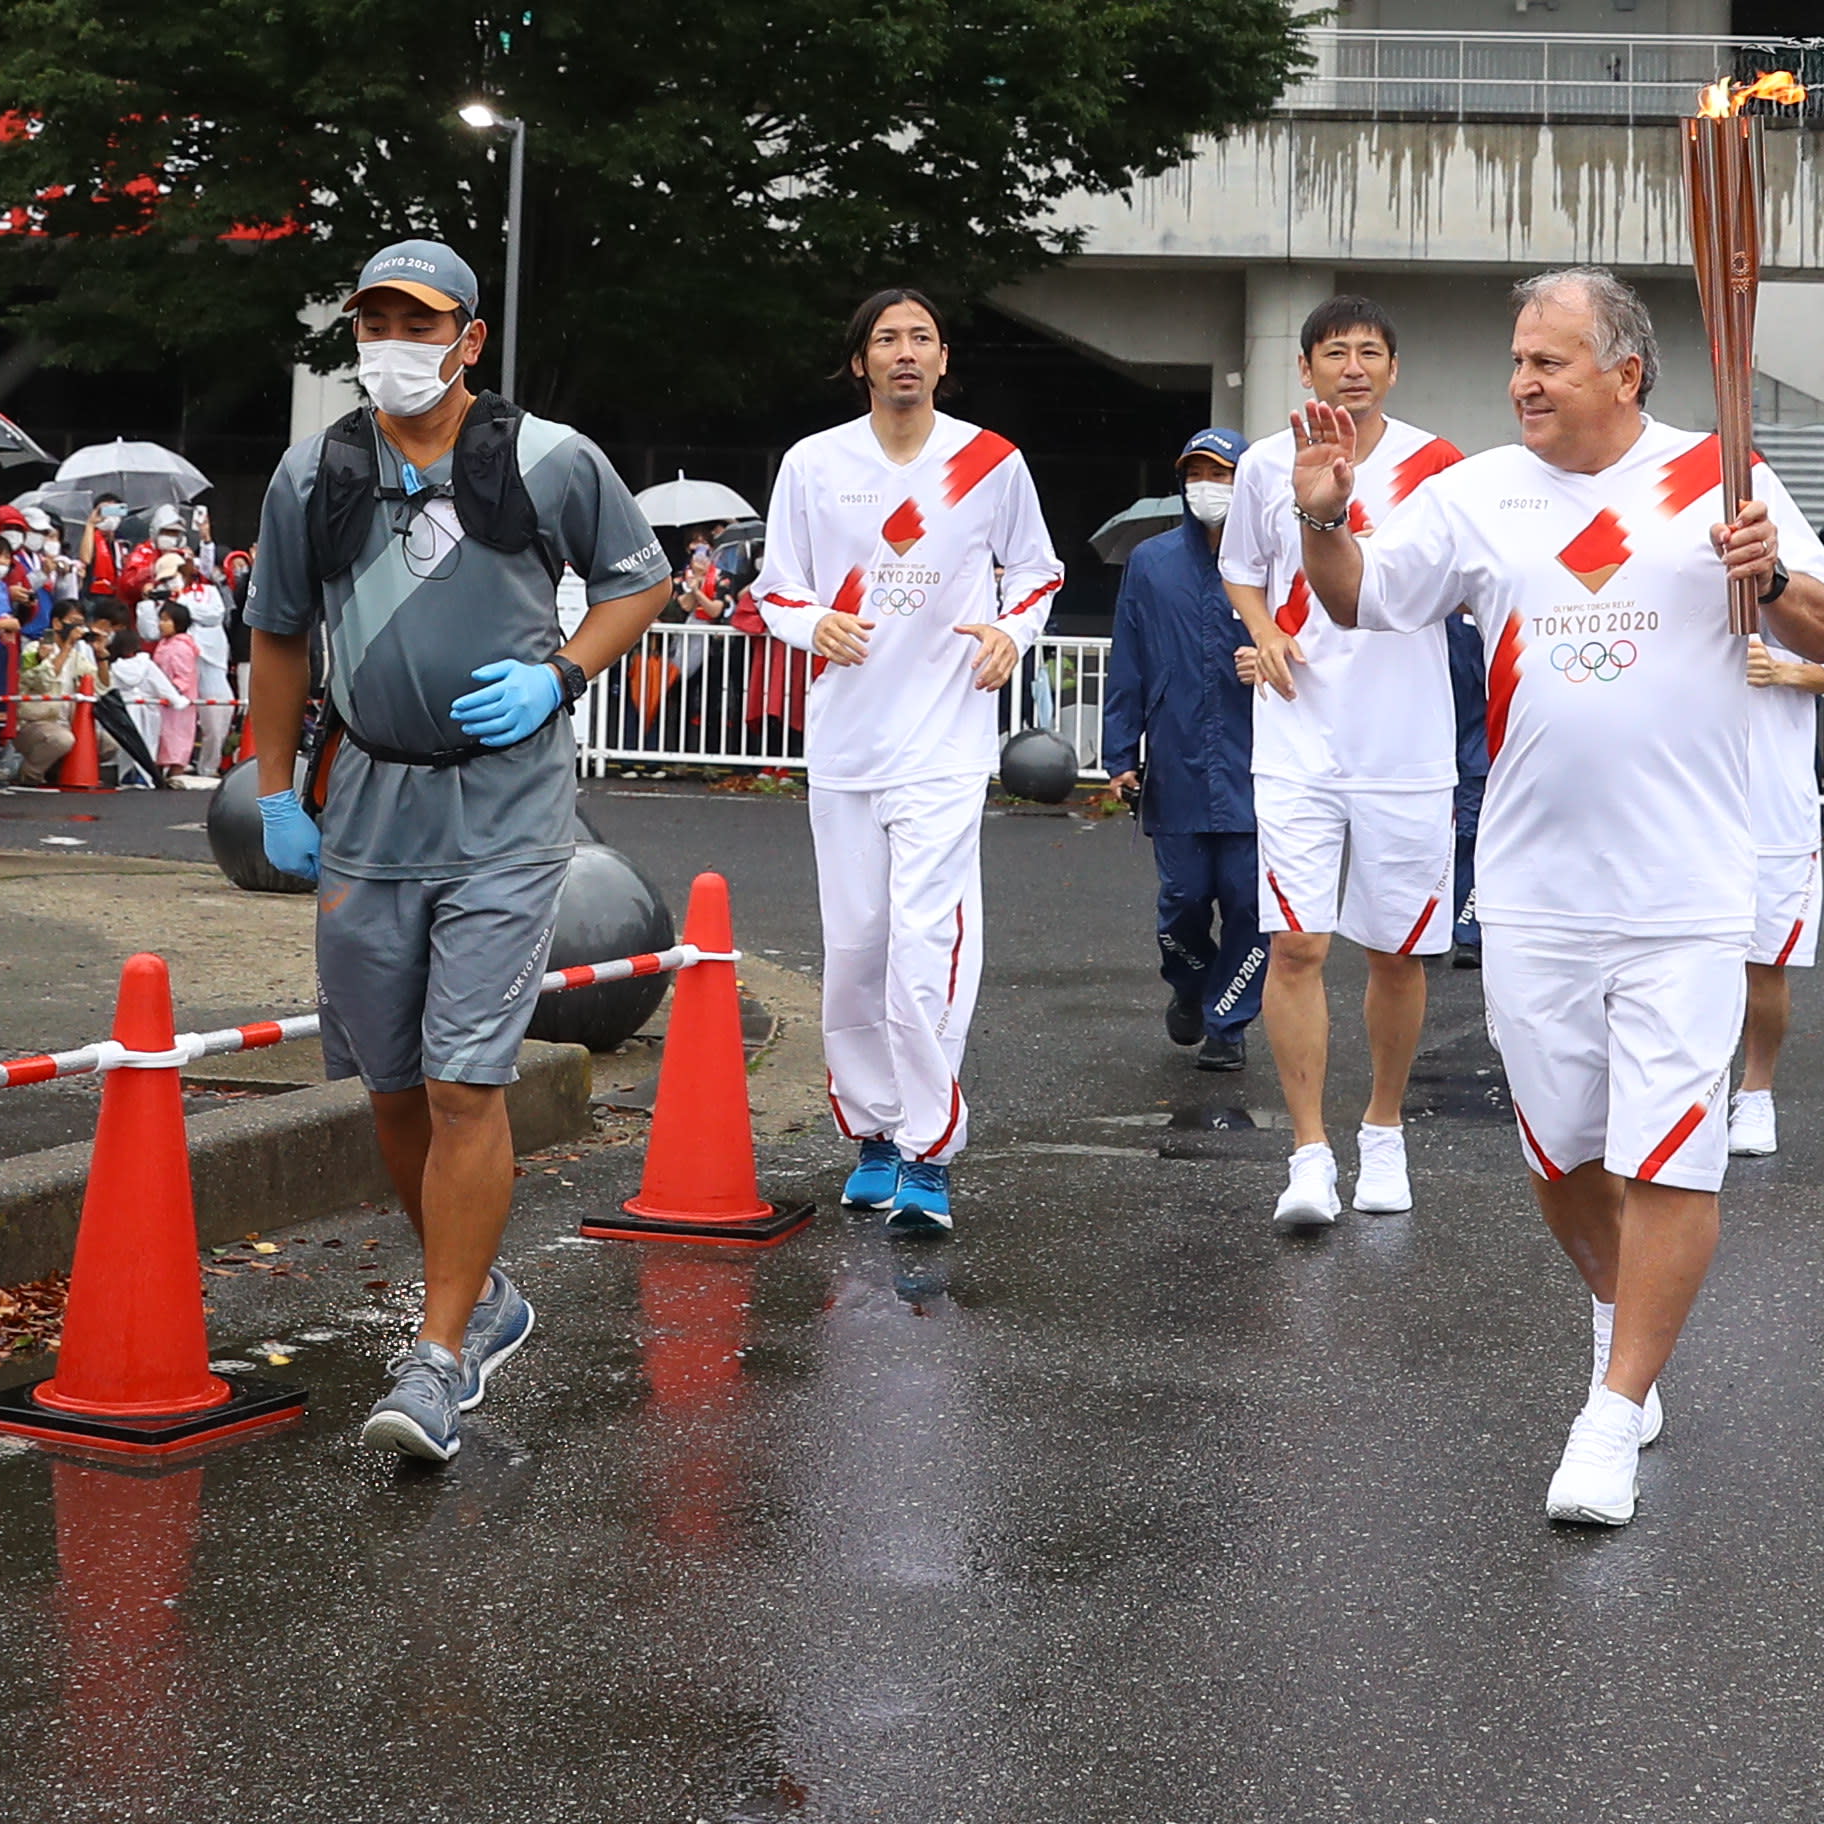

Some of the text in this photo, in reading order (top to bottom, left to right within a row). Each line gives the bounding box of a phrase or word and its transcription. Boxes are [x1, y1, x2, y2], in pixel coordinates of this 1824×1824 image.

[406, 258, 436, 273] 2020
[1499, 498, 1549, 510] 0950121
[616, 547, 651, 573] TOKYO
[906, 571, 941, 585] 2020
[1553, 600, 1636, 614] OLYMPIC TORCH RELAY
[1532, 611, 1658, 637] TOKYO 2020
[1214, 947, 1266, 1016] TOKYO 2020
